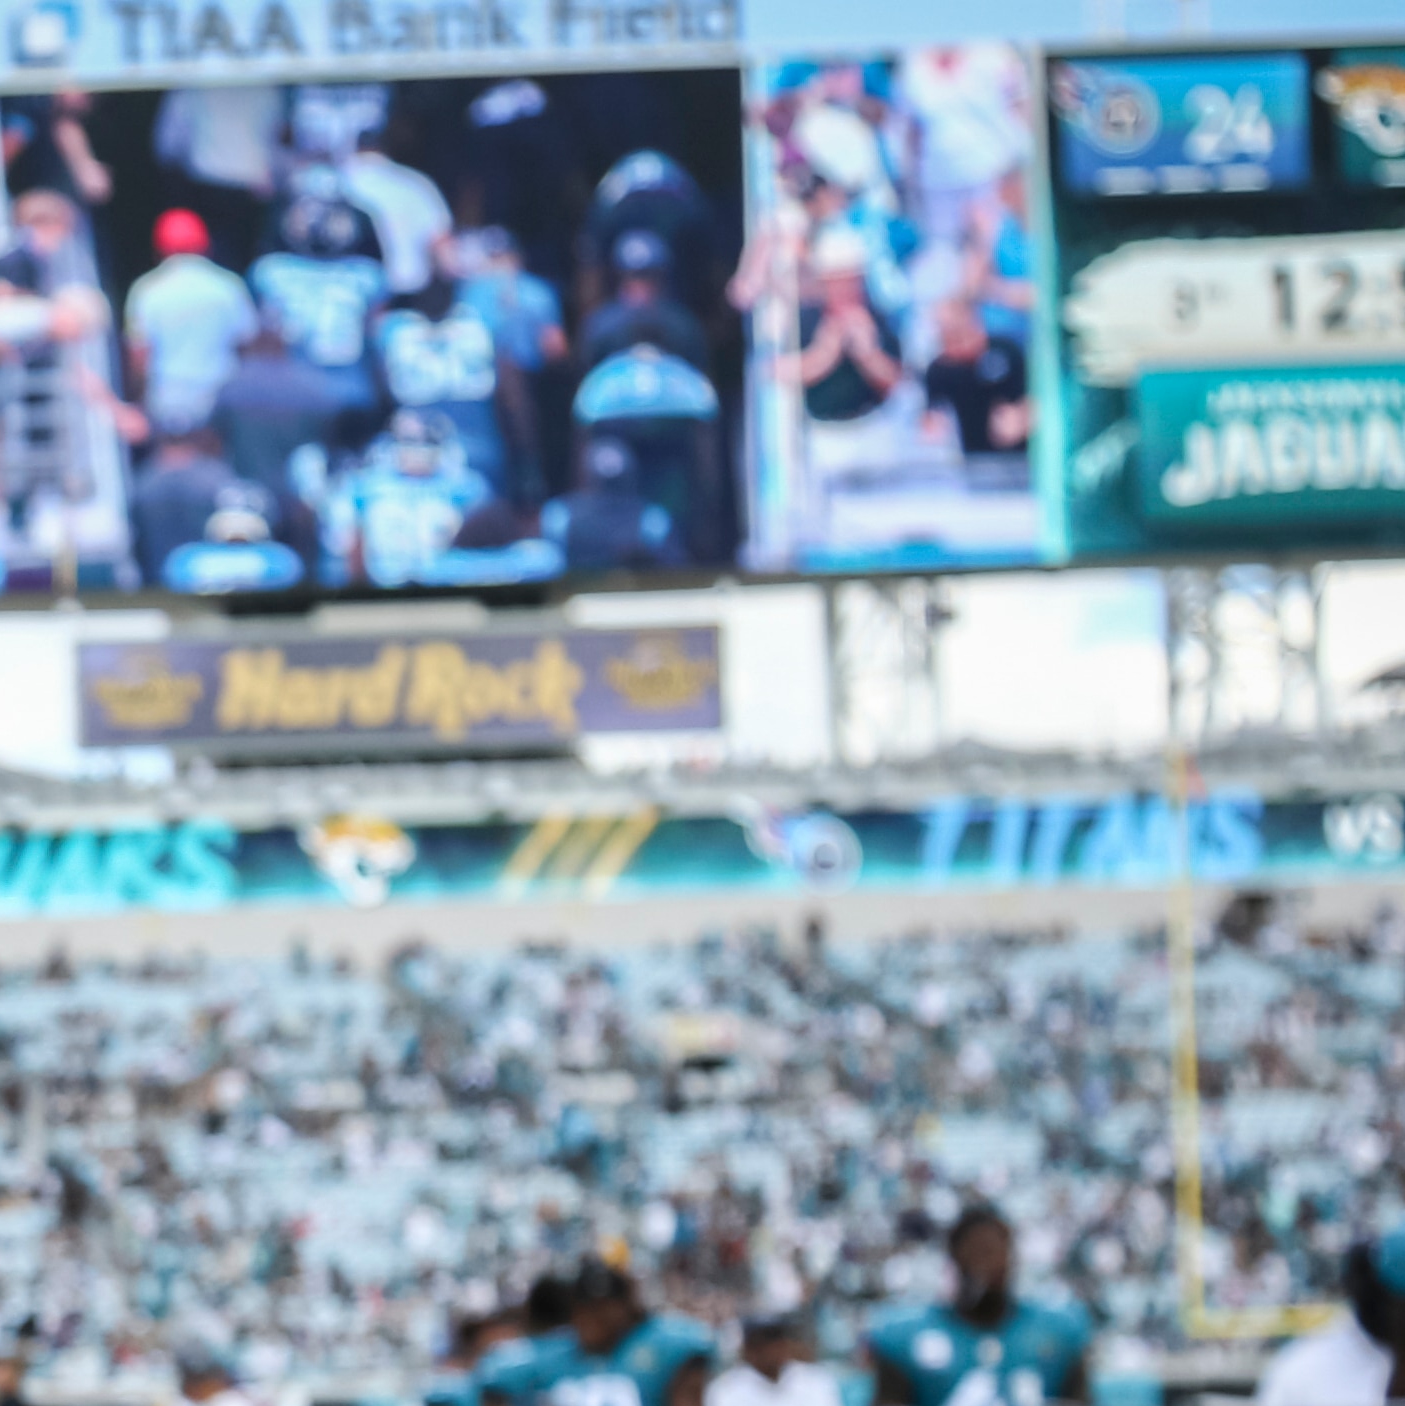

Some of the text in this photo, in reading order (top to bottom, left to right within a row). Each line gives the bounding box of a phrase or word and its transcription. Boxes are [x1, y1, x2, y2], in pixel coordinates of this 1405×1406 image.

[1182, 83, 1276, 164] 24
[216, 640, 583, 742] Hard Rock
[919, 788, 1266, 886] TITANS
